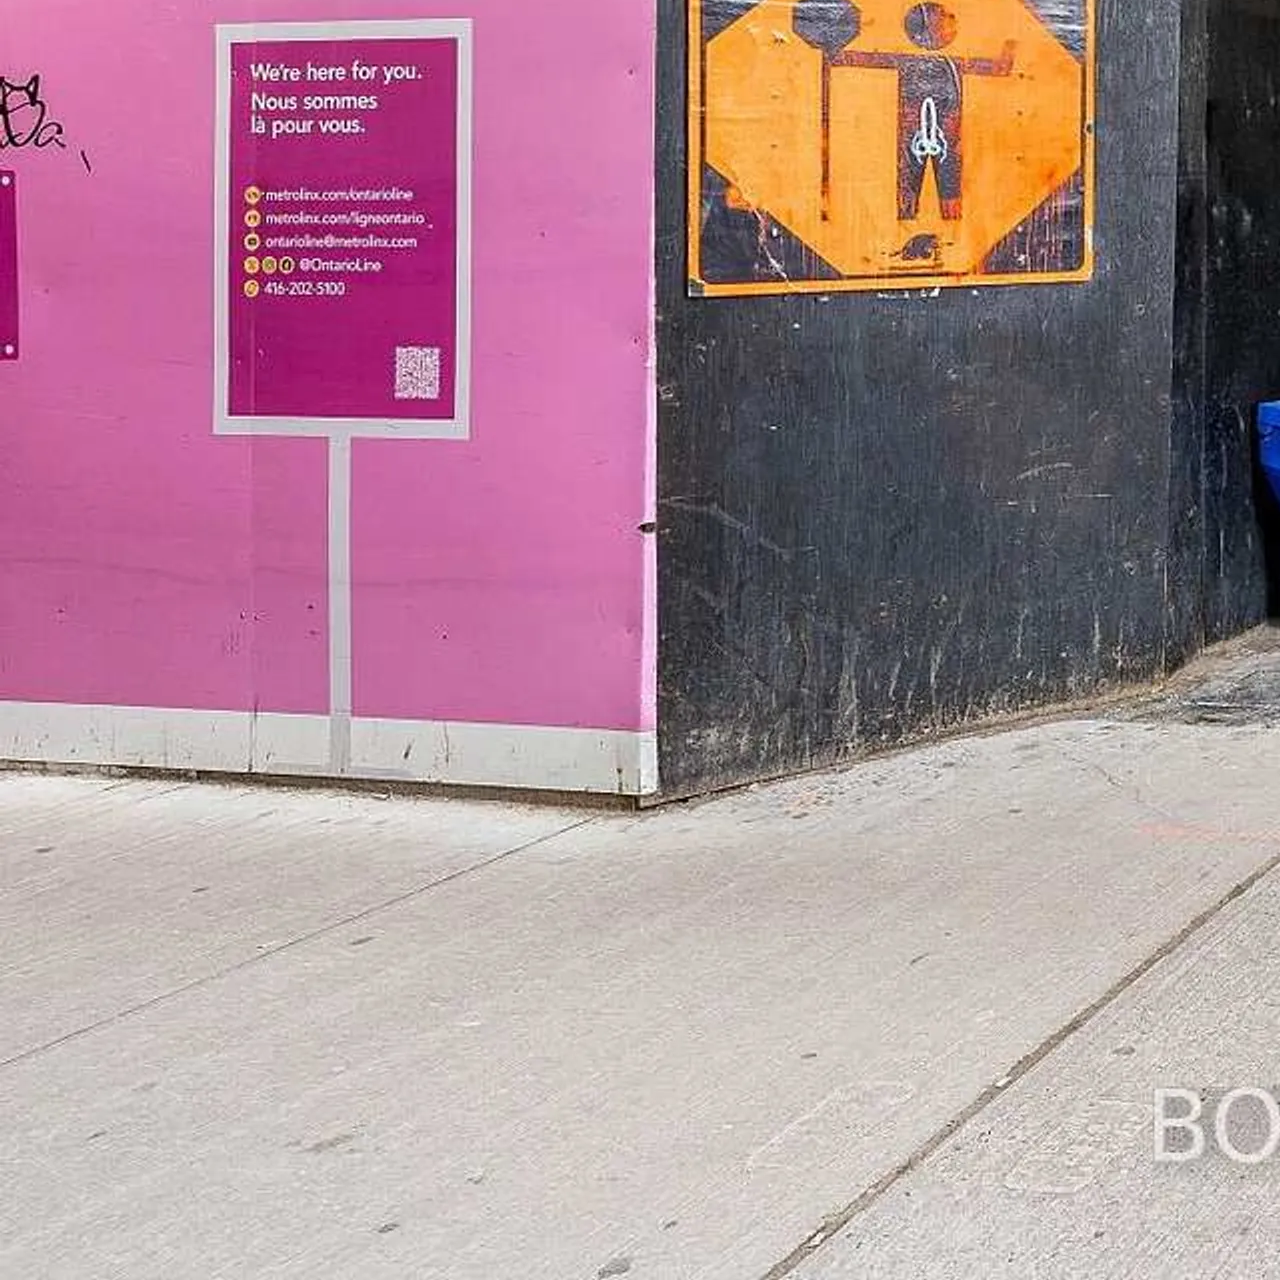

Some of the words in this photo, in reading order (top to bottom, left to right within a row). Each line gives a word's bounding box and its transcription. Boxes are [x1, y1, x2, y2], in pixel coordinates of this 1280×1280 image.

[250, 62, 301, 81] We're
[306, 61, 347, 81] here
[352, 59, 378, 80] for
[383, 65, 423, 85] you.
[251, 91, 298, 111] Nous
[303, 95, 378, 111] sommes
[272, 119, 314, 139] pour
[318, 119, 366, 134] vous.
[264, 281, 346, 296] 416-202-5100
